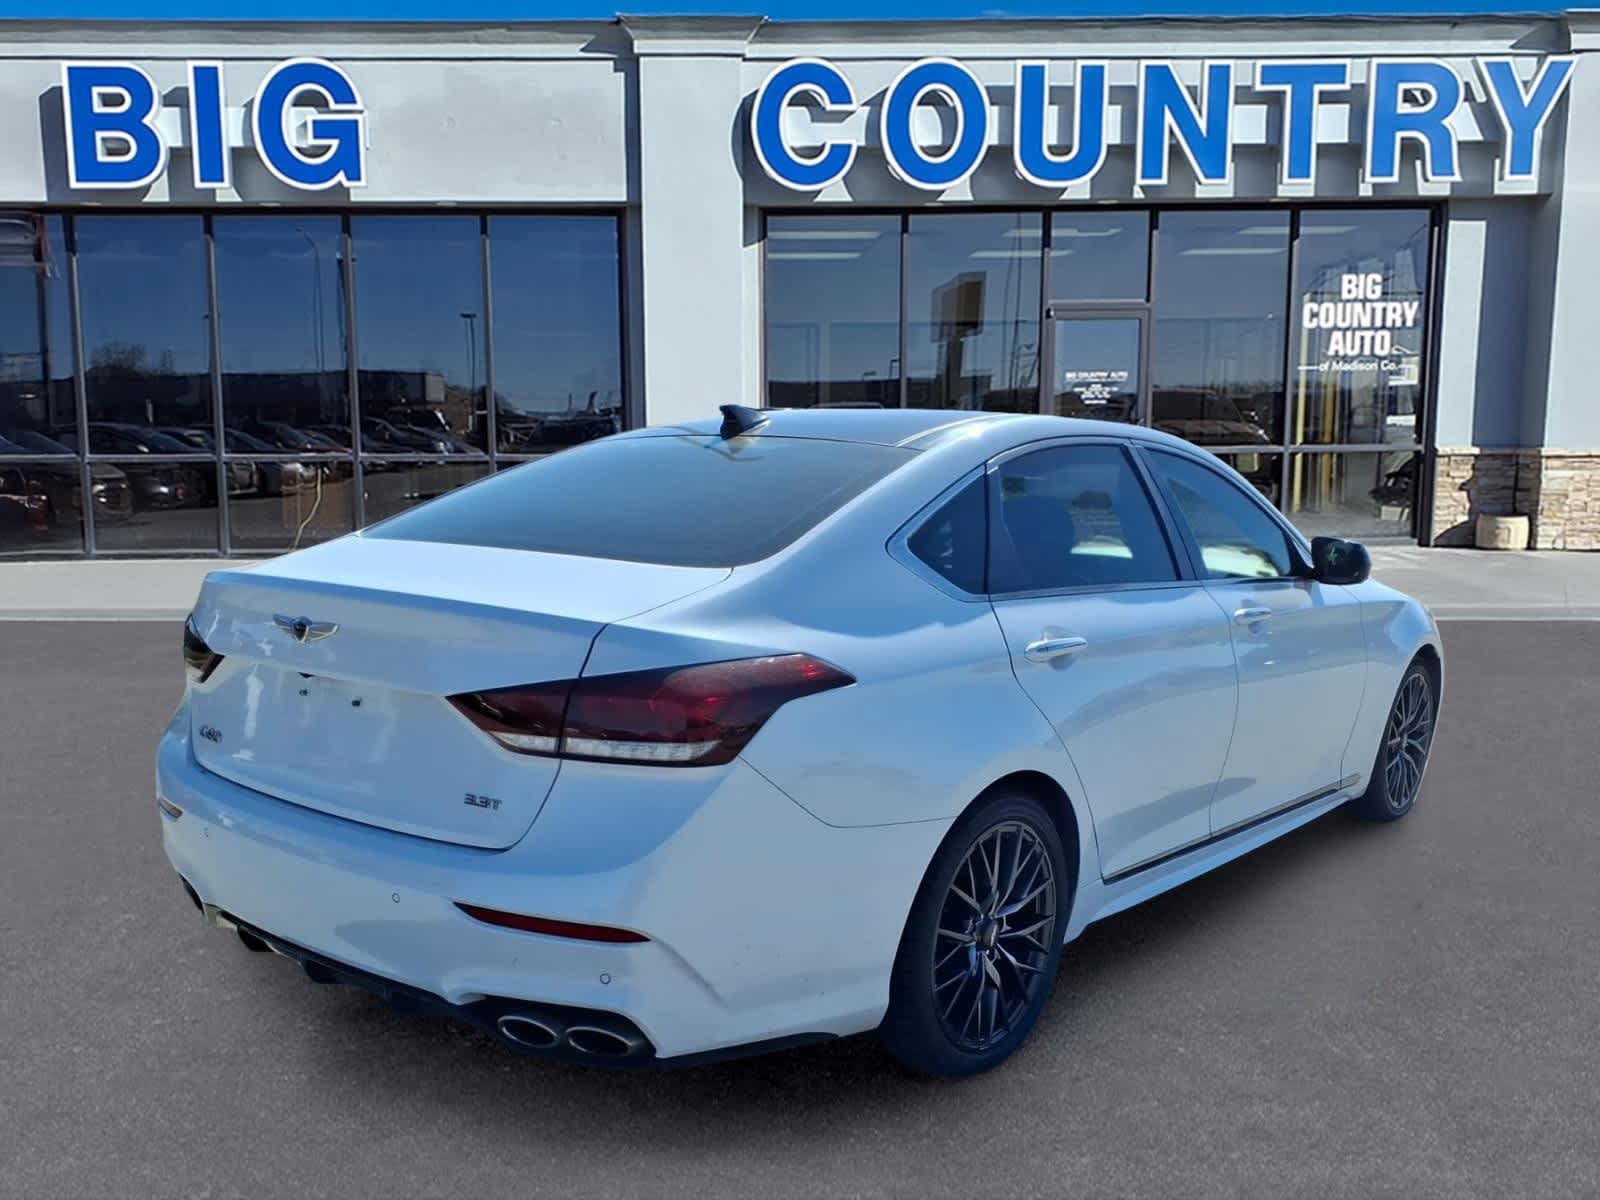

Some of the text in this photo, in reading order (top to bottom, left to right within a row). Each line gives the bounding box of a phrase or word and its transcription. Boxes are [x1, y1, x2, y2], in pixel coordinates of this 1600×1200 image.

[62, 56, 1576, 192] BIG COUNTRY
[1341, 273, 1382, 300] BIG
[1303, 302, 1419, 328] COUNTRY
[1328, 330, 1391, 356] AUTO
[1331, 361, 1378, 371] Madison
